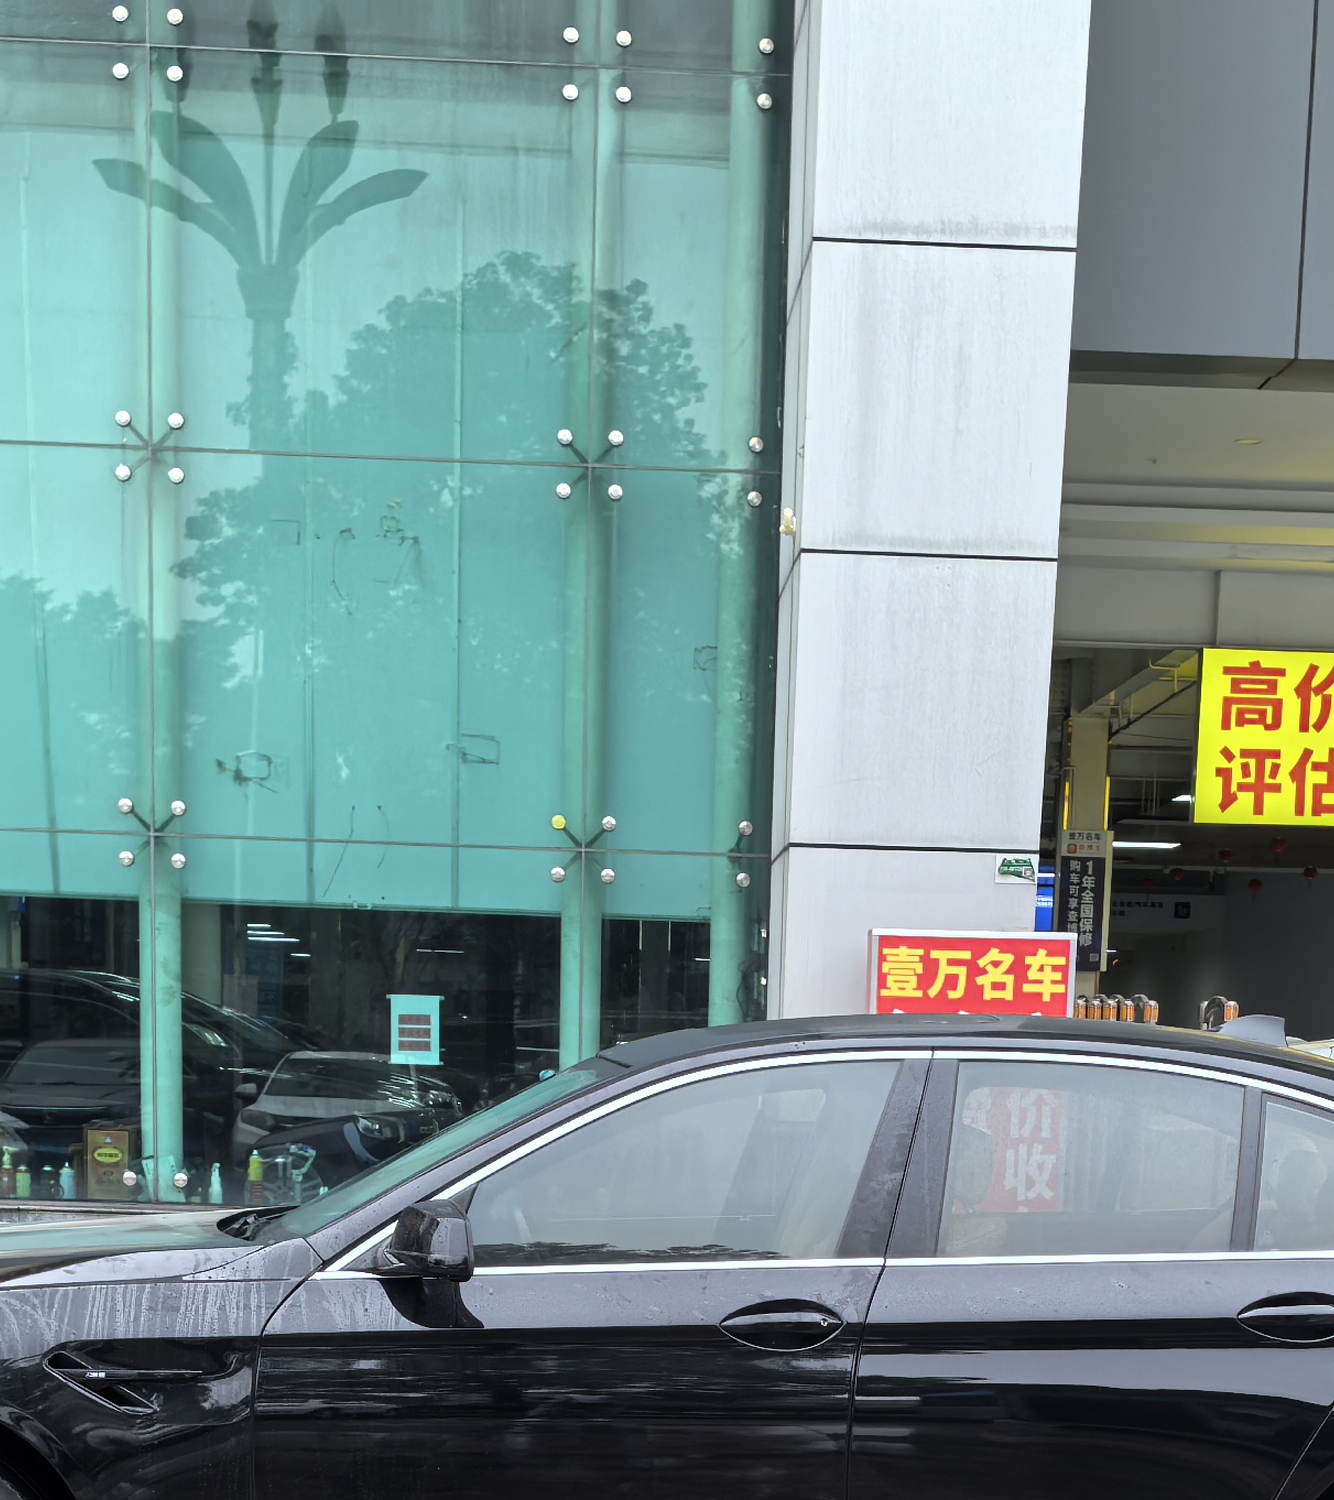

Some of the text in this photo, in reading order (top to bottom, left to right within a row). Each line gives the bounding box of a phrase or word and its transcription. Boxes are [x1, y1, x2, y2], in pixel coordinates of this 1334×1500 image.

[1078, 860, 1096, 947] 1年全国保修
[879, 945, 1068, 1002] 壹万名车
[1003, 1088, 1058, 1213] 价收
